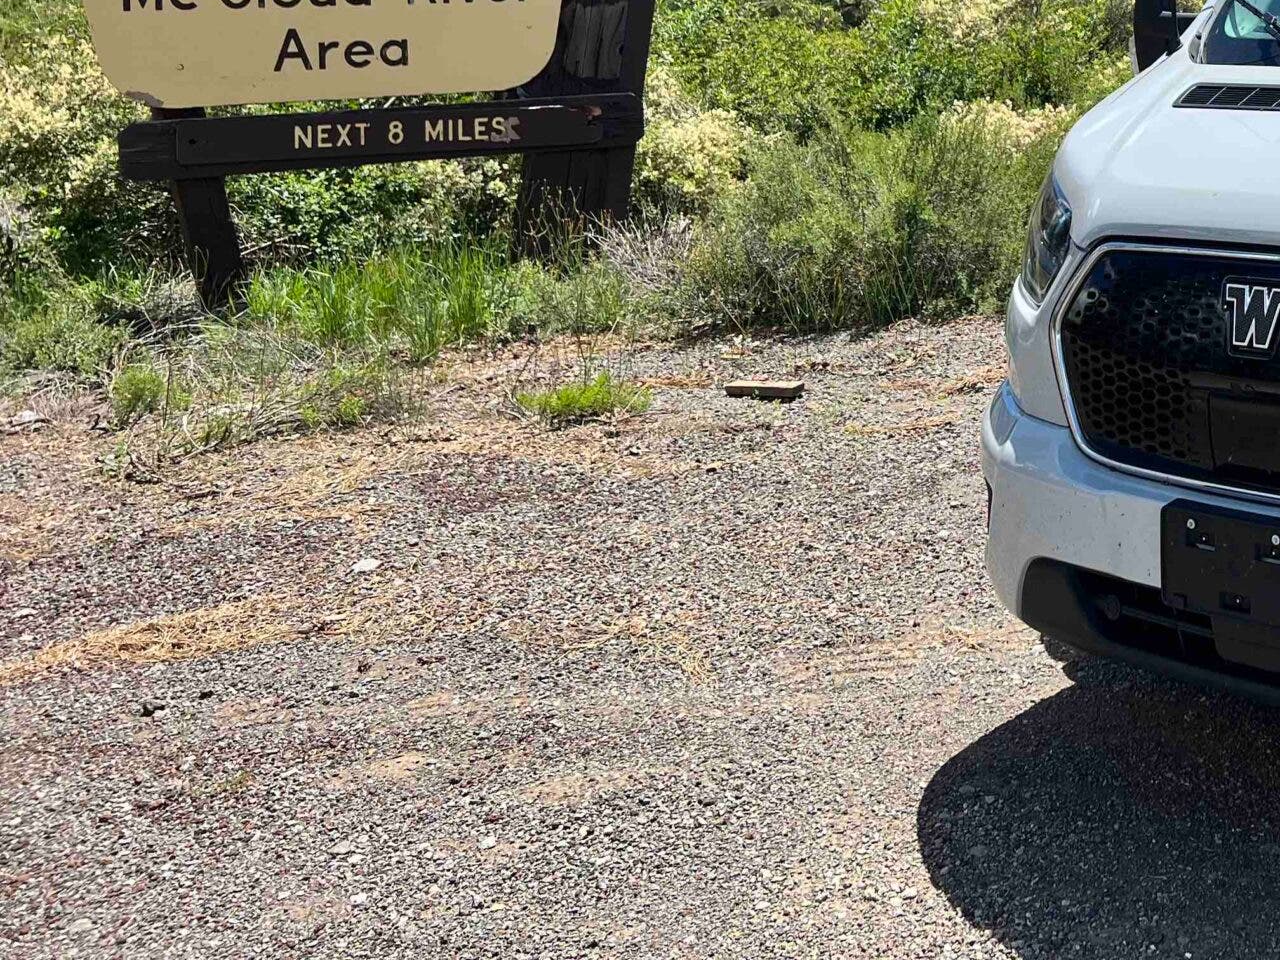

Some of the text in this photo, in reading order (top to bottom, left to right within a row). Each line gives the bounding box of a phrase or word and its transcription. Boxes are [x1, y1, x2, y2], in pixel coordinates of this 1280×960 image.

[272, 27, 410, 73] Area
[294, 116, 508, 150] NEXT 8 MILES
